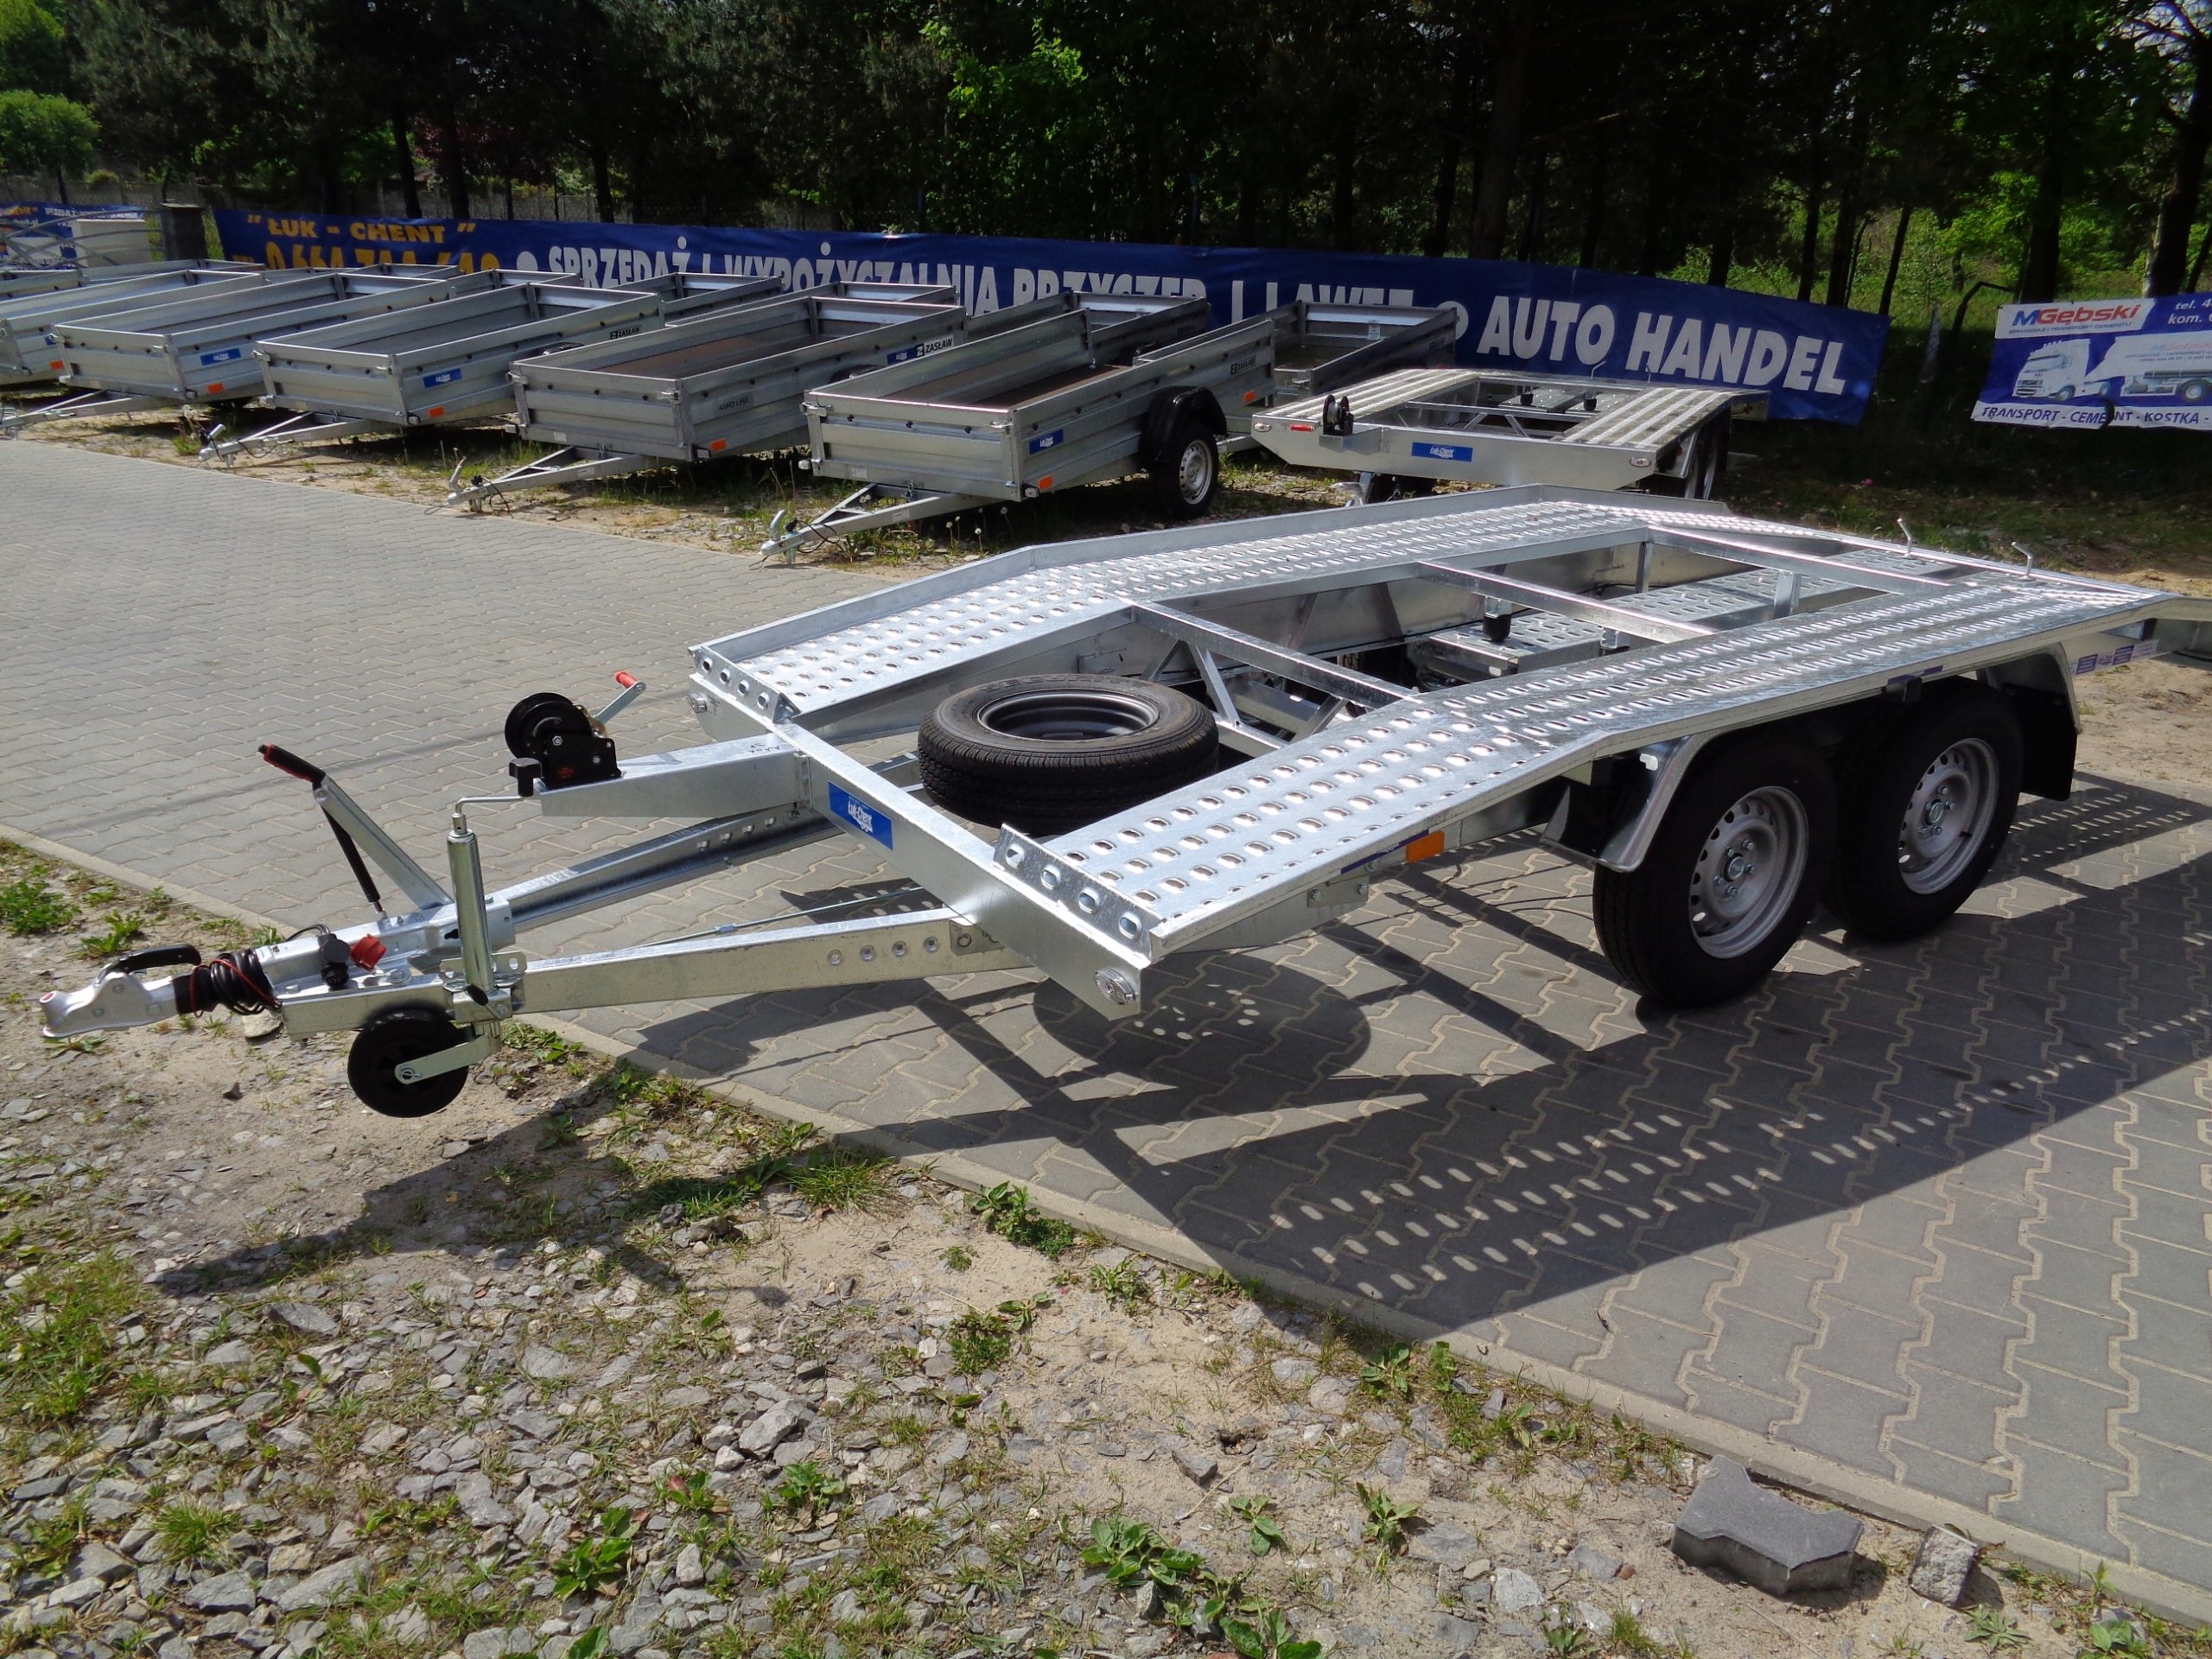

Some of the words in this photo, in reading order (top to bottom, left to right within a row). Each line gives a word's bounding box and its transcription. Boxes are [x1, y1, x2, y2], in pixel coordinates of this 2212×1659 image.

[268, 218, 318, 238] ŁUK
[350, 222, 445, 244] CHENT
[549, 236, 690, 289] SPRZEDAŻ
[2176, 300, 2196, 310] tel.
[2202, 298, 2212, 308] 4
[2012, 305, 2142, 326] MGębski
[2168, 314, 2202, 324] kom.
[926, 338, 953, 353] ZASŁAW
[1477, 296, 1615, 365] AUTO
[1625, 312, 1847, 395] HANDEL
[1981, 406, 2060, 422] TRANSPORT
[2144, 412, 2199, 424] KOSTKA
